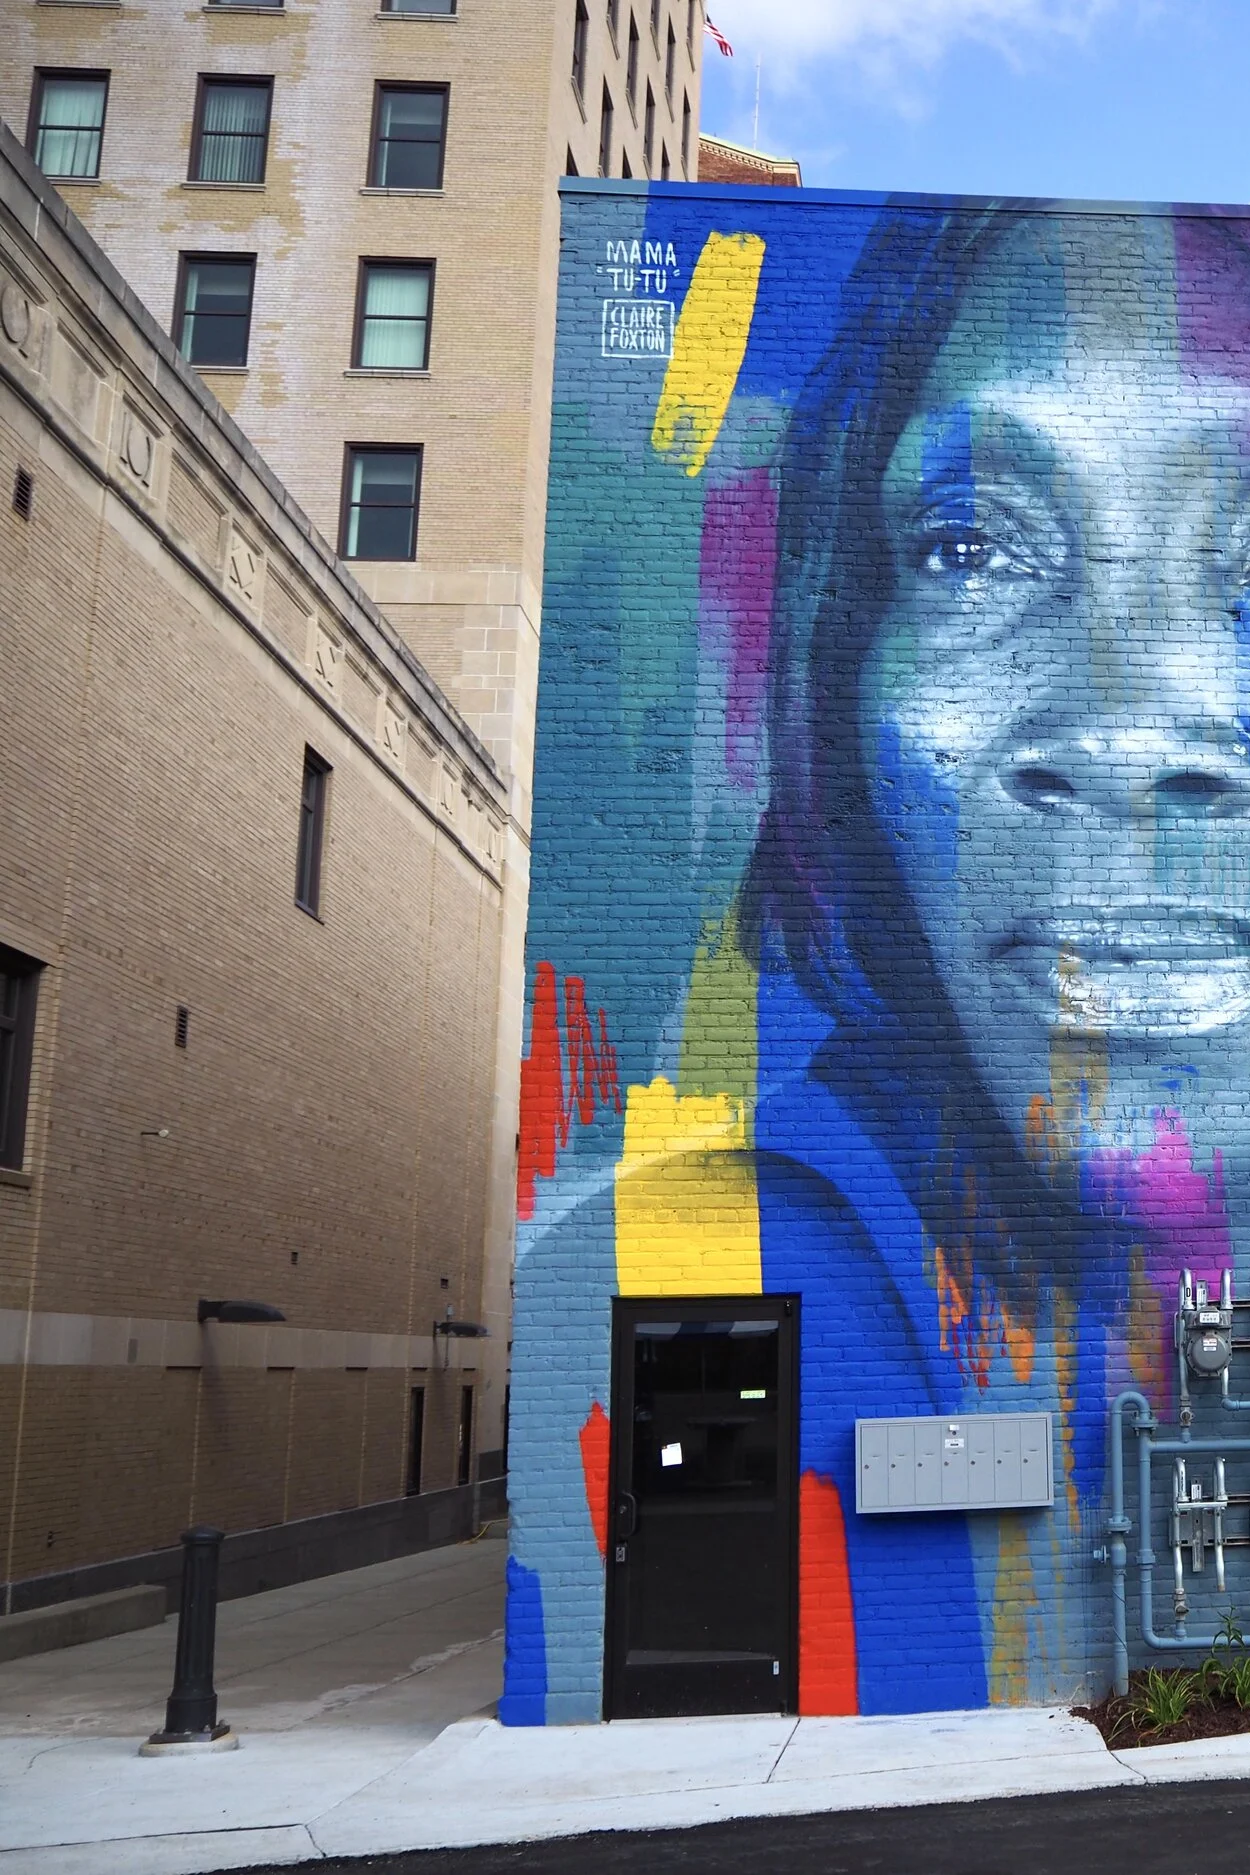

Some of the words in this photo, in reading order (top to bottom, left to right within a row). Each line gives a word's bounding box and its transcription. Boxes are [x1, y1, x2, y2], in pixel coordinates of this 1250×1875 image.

[606, 239, 677, 267] MAMA
[610, 306, 665, 329] CLAIRE
[609, 327, 666, 353] FOXTON
